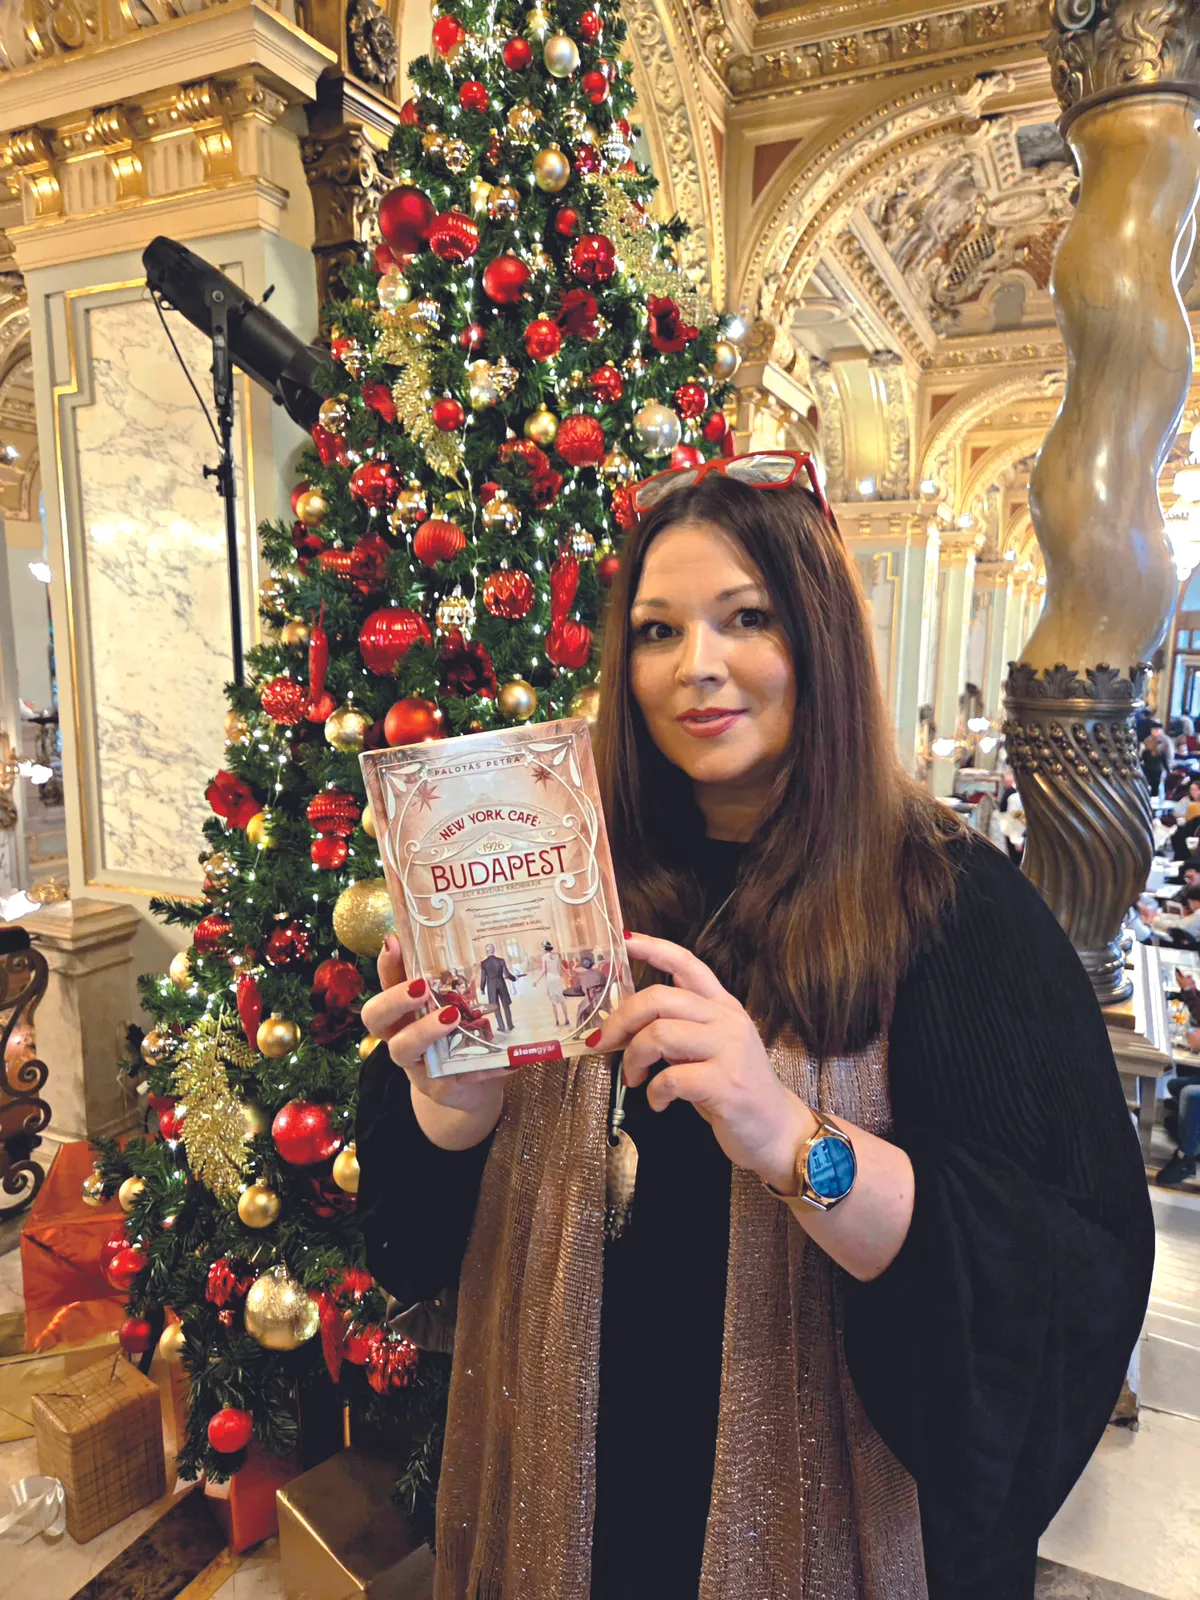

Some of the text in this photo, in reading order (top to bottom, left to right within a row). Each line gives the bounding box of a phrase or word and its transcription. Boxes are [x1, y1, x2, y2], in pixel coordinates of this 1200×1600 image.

[486, 756, 520, 768] PETRA
[439, 809, 539, 841] NEW YORK CAFÉ
[482, 841, 505, 852] 1926
[430, 844, 567, 893] BUDAPEST
